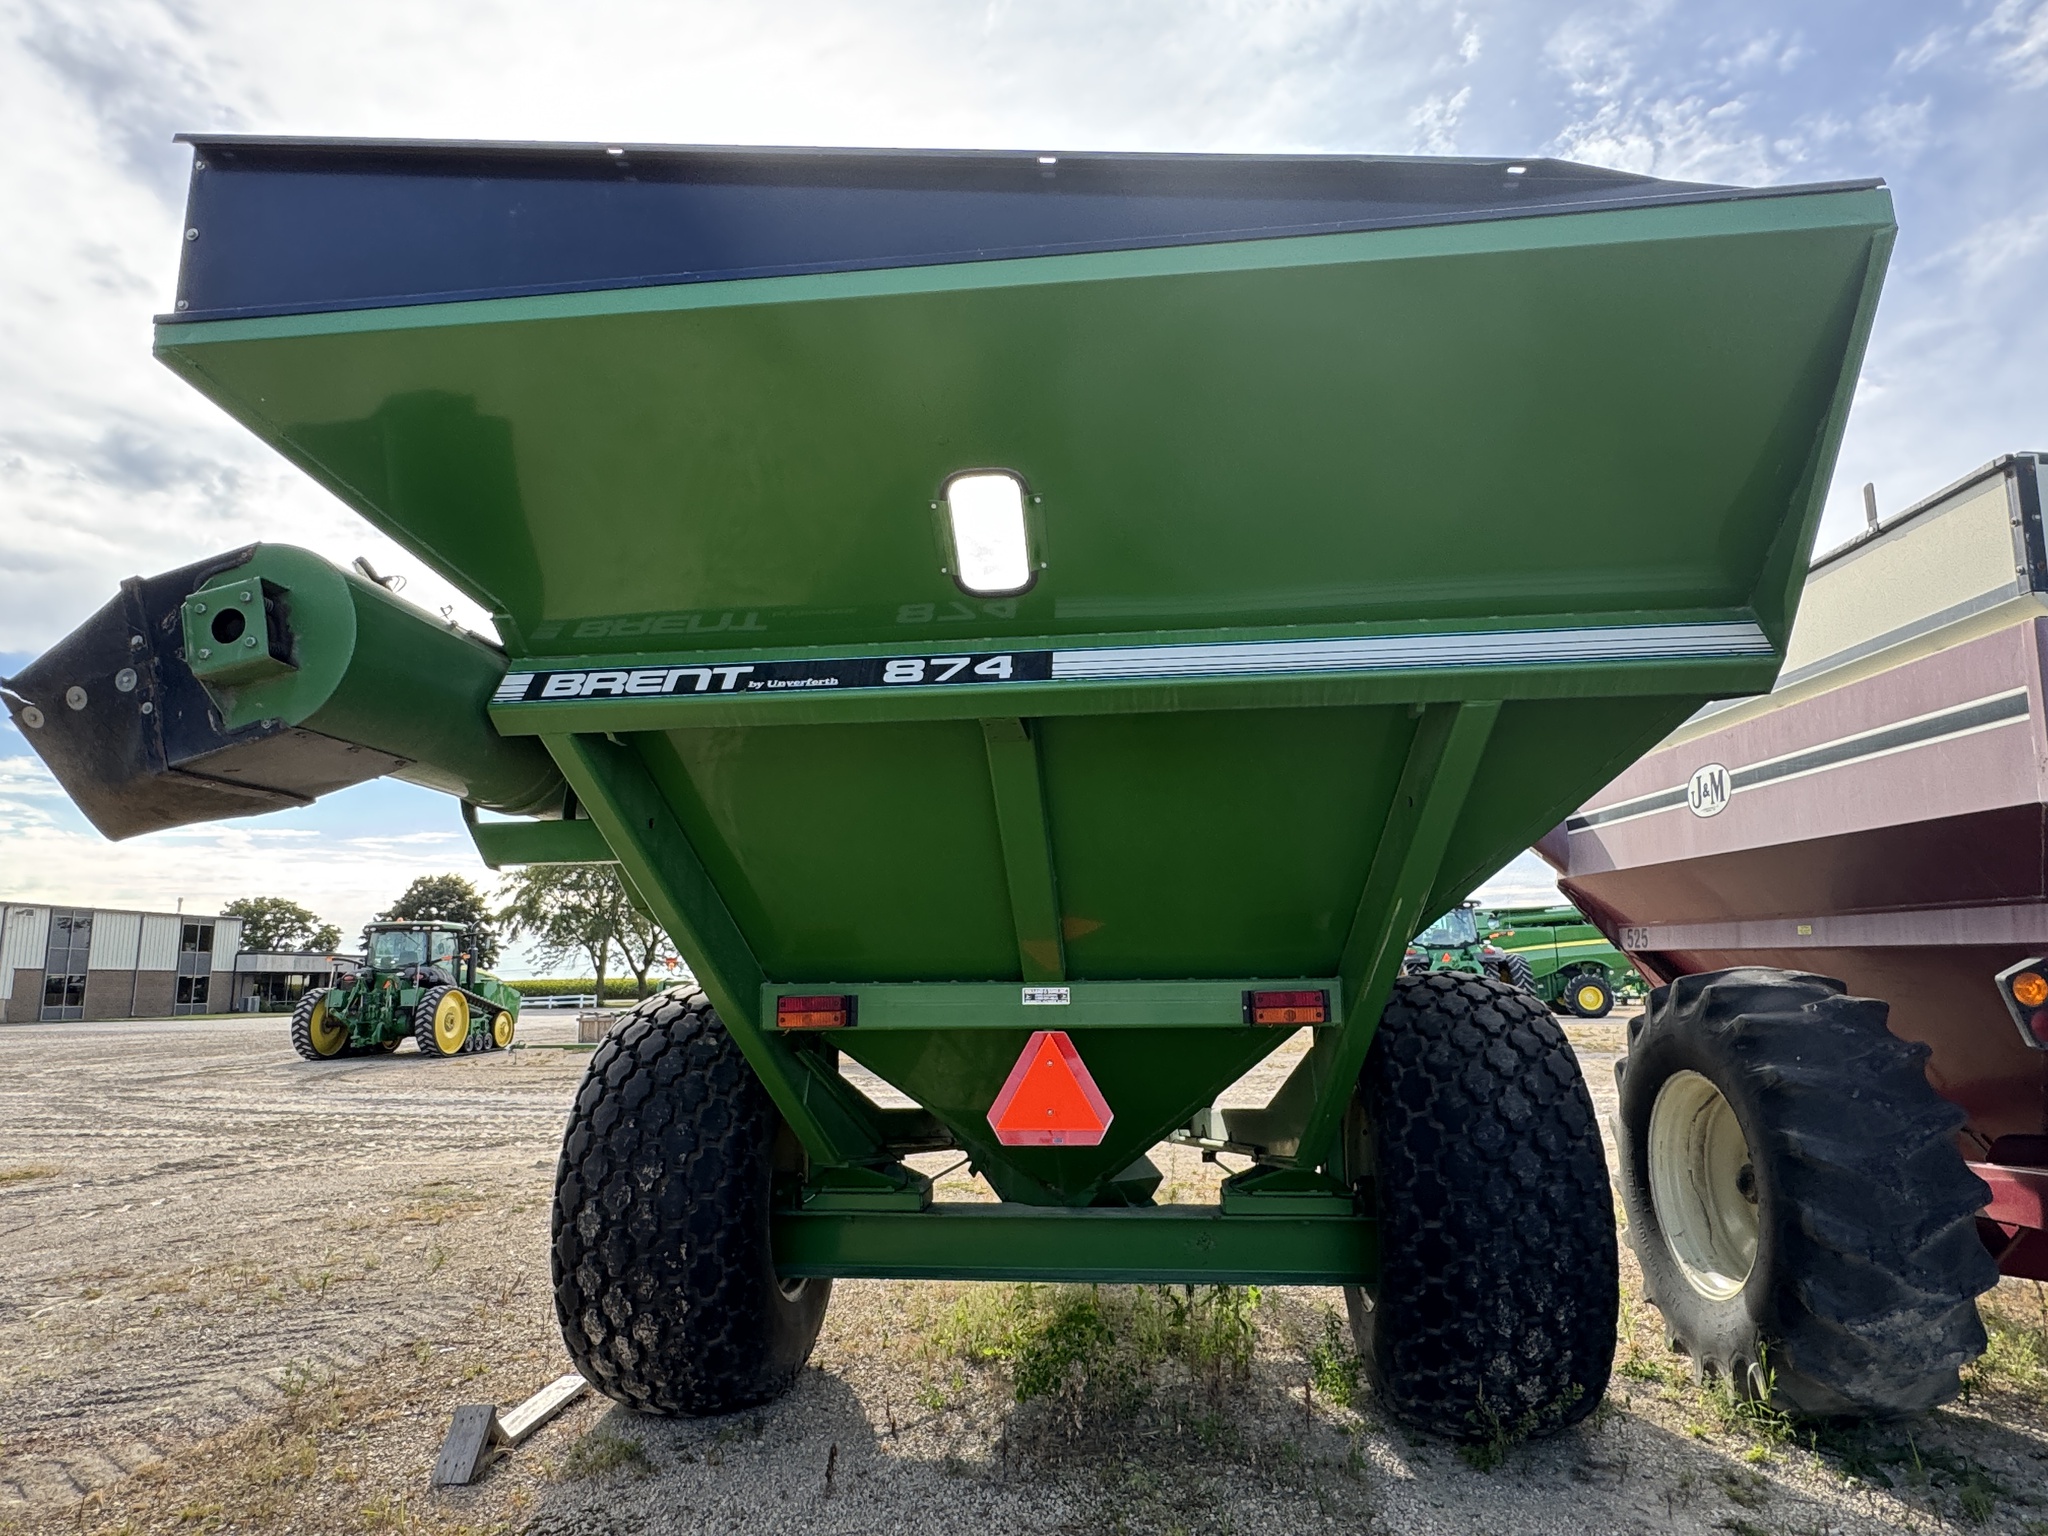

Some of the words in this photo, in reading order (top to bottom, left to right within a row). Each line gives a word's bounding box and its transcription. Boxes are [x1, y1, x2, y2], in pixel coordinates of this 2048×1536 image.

[541, 666, 754, 698] BRENT
[748, 681, 764, 690] by
[883, 655, 1013, 683] 874
[1691, 769, 1726, 809] J&M
[1627, 928, 1648, 948] 525
